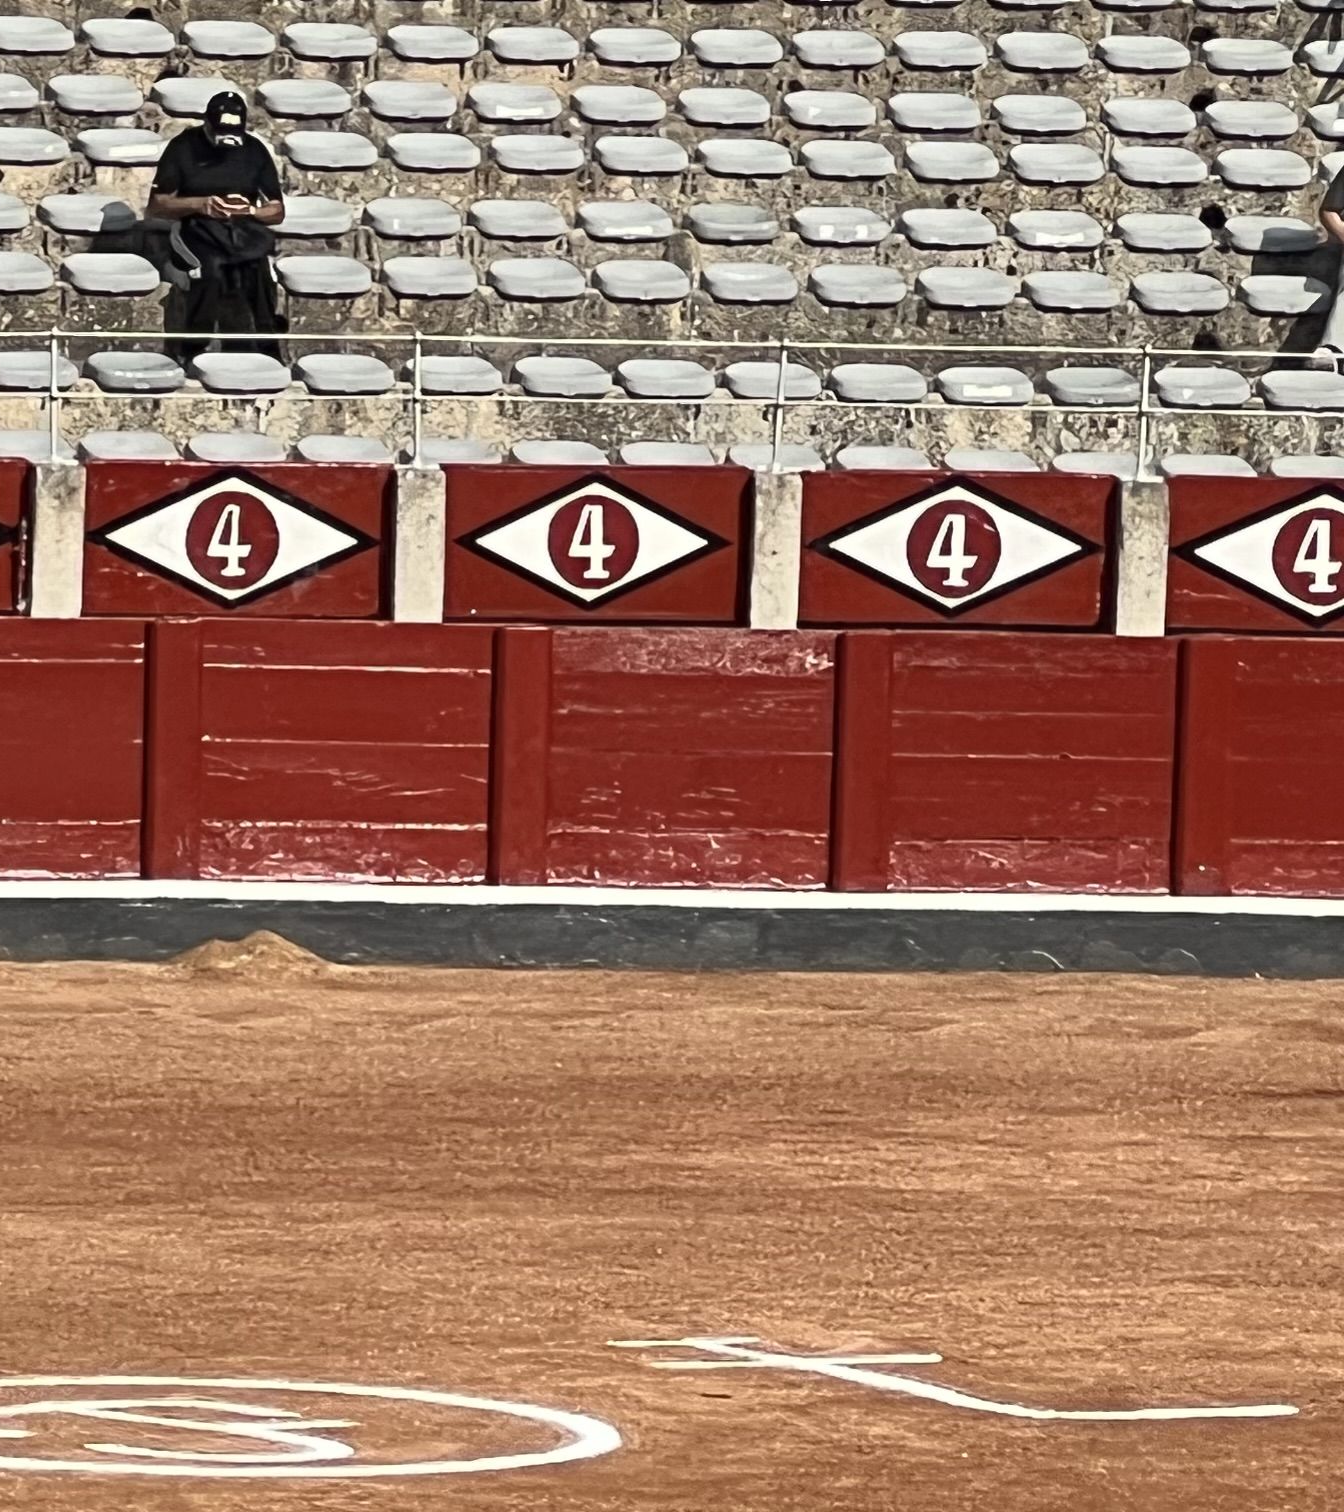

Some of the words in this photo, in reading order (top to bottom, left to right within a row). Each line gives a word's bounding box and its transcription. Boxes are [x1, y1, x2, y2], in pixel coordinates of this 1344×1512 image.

[207, 504, 251, 576] 4
[568, 504, 615, 578] 4
[926, 514, 978, 587] 4
[1293, 519, 1342, 592] 4
